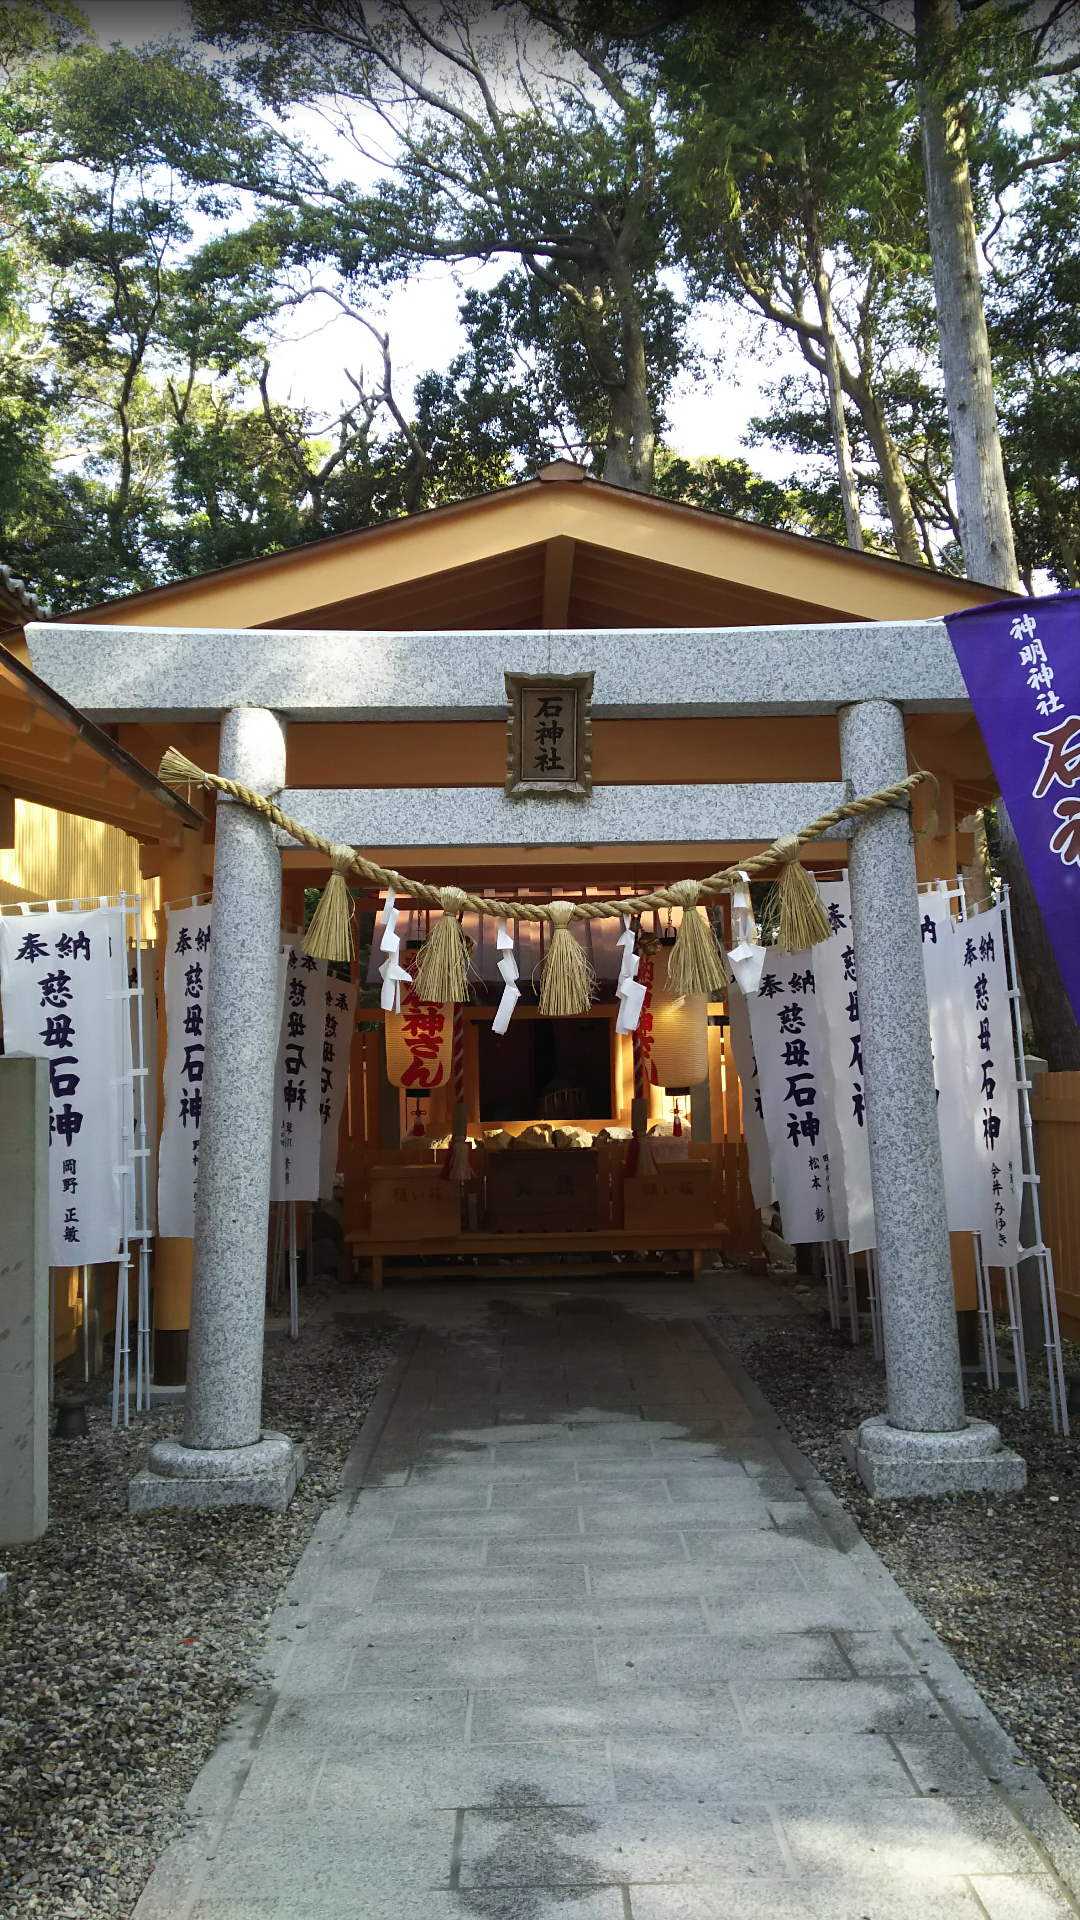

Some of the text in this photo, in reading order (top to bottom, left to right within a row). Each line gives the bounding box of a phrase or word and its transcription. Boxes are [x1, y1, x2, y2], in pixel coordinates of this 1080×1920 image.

[1010, 613, 1065, 717] 神明神社
[533, 696, 565, 773] 石神社
[14, 932, 91, 963] 奉納
[757, 969, 816, 999] 奉納
[963, 931, 996, 968] 奉納
[37, 969, 84, 1148] 慈母石神
[178, 961, 205, 1130] 慈母石神
[776, 1002, 821, 1148] 慈母石神
[974, 972, 1002, 1151] 慈母石神
